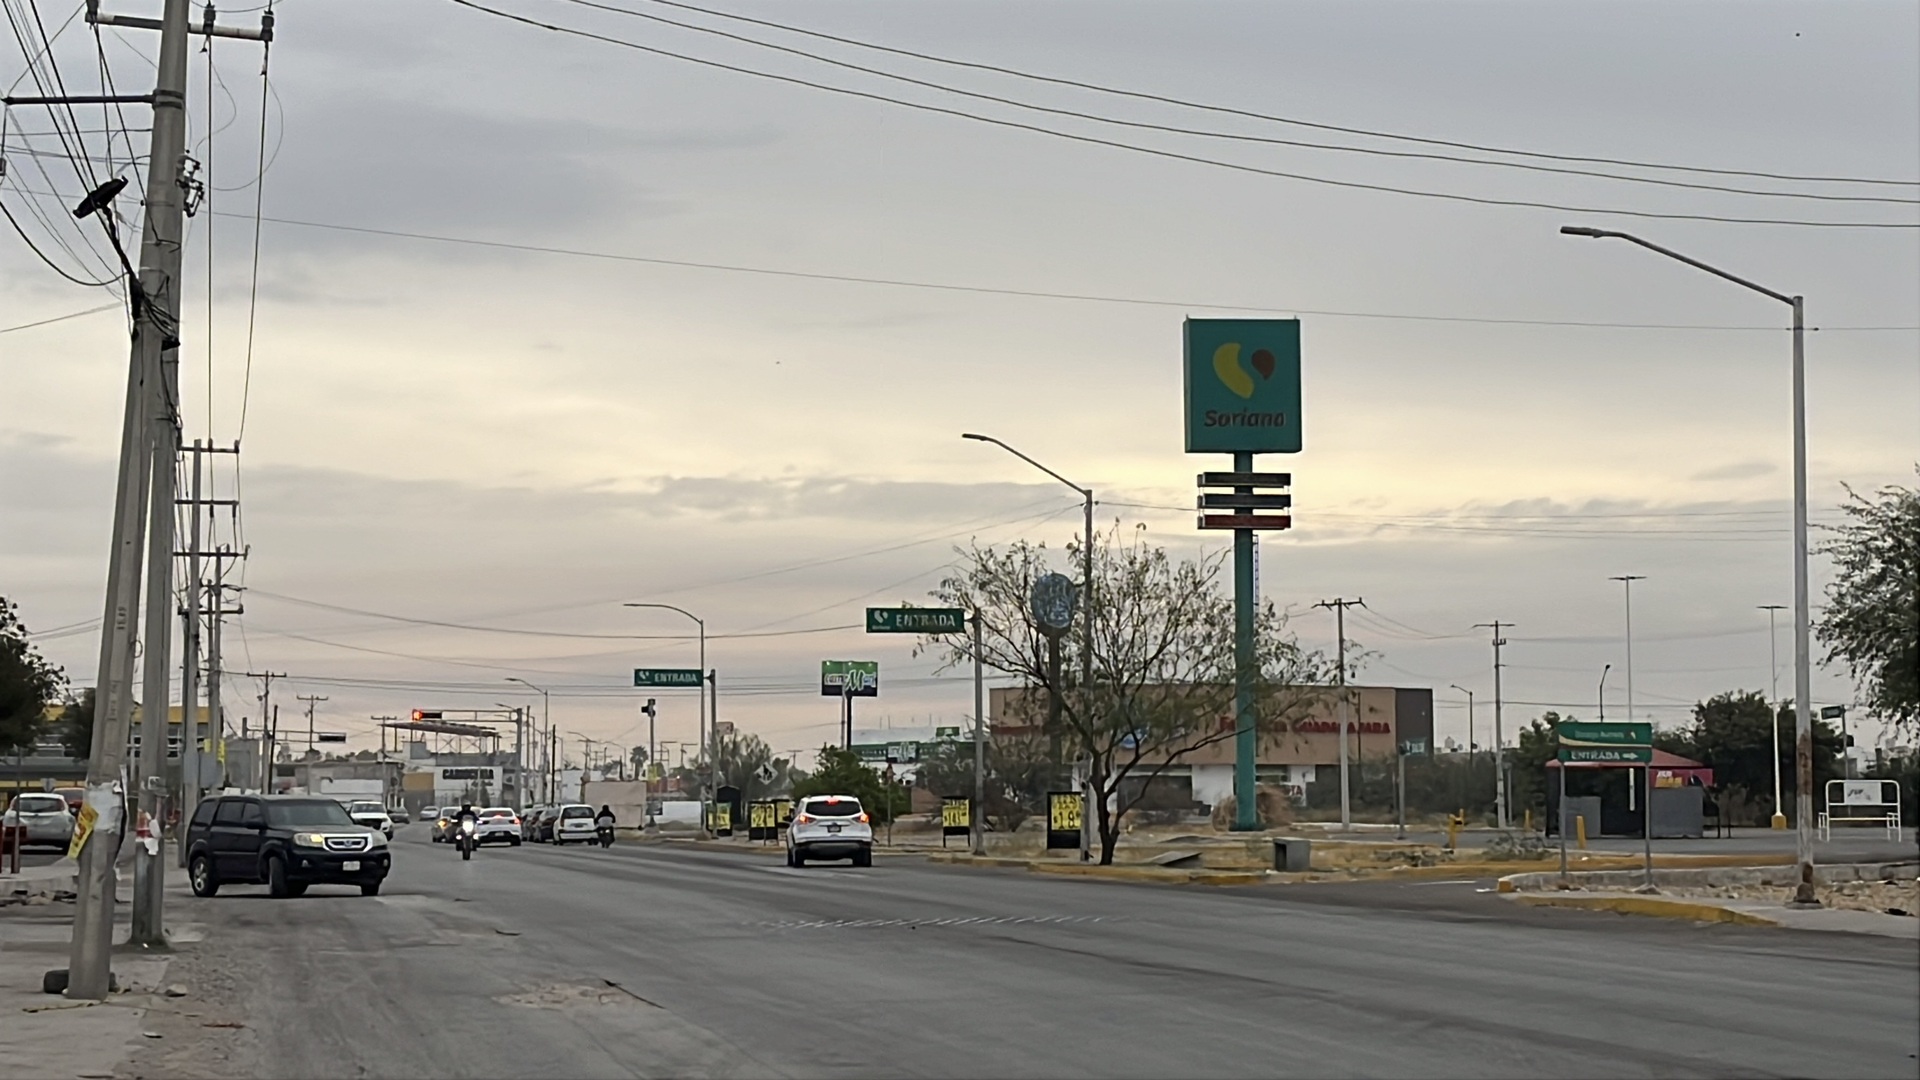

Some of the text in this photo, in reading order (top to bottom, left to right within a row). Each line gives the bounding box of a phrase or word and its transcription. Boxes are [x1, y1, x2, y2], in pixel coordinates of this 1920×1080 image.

[1204, 407, 1286, 427] Soriana
[896, 614, 956, 628] ENTRADA
[654, 673, 697, 682] ENTRADA
[1571, 751, 1620, 760] ENTRADA
